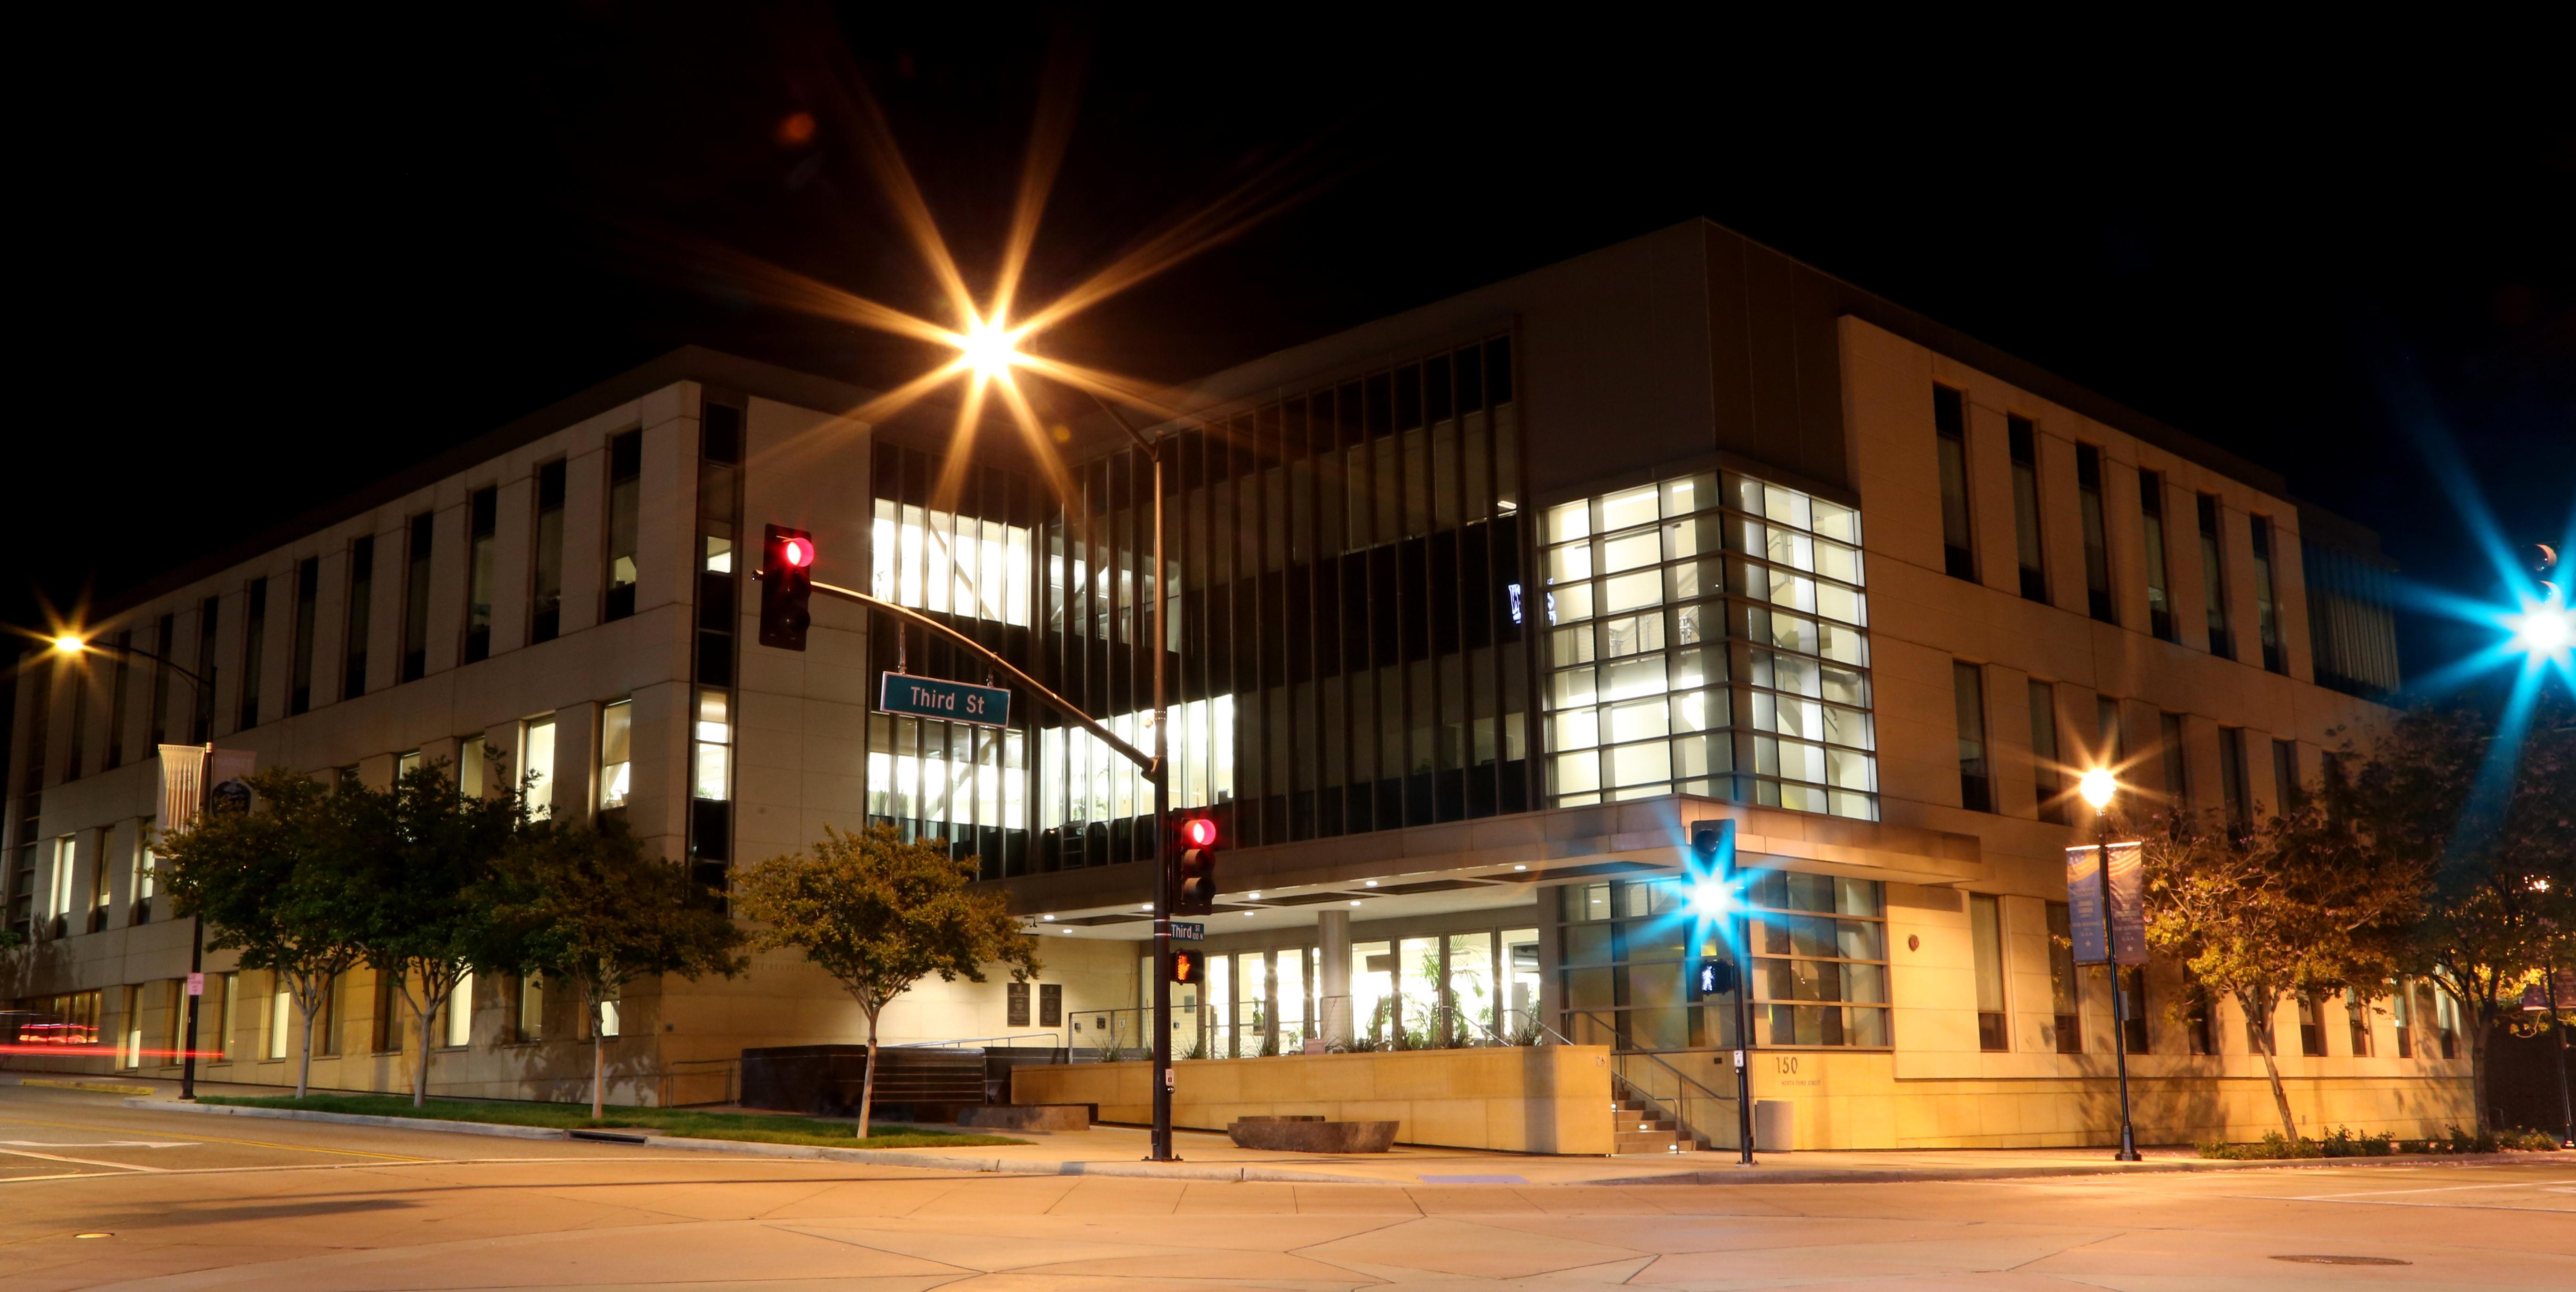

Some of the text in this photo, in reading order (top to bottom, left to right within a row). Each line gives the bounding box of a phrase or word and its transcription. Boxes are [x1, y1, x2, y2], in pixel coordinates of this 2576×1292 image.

[910, 686, 984, 714] Third St
[1171, 924, 1192, 939] Third
[1776, 1056, 1798, 1074] 150
